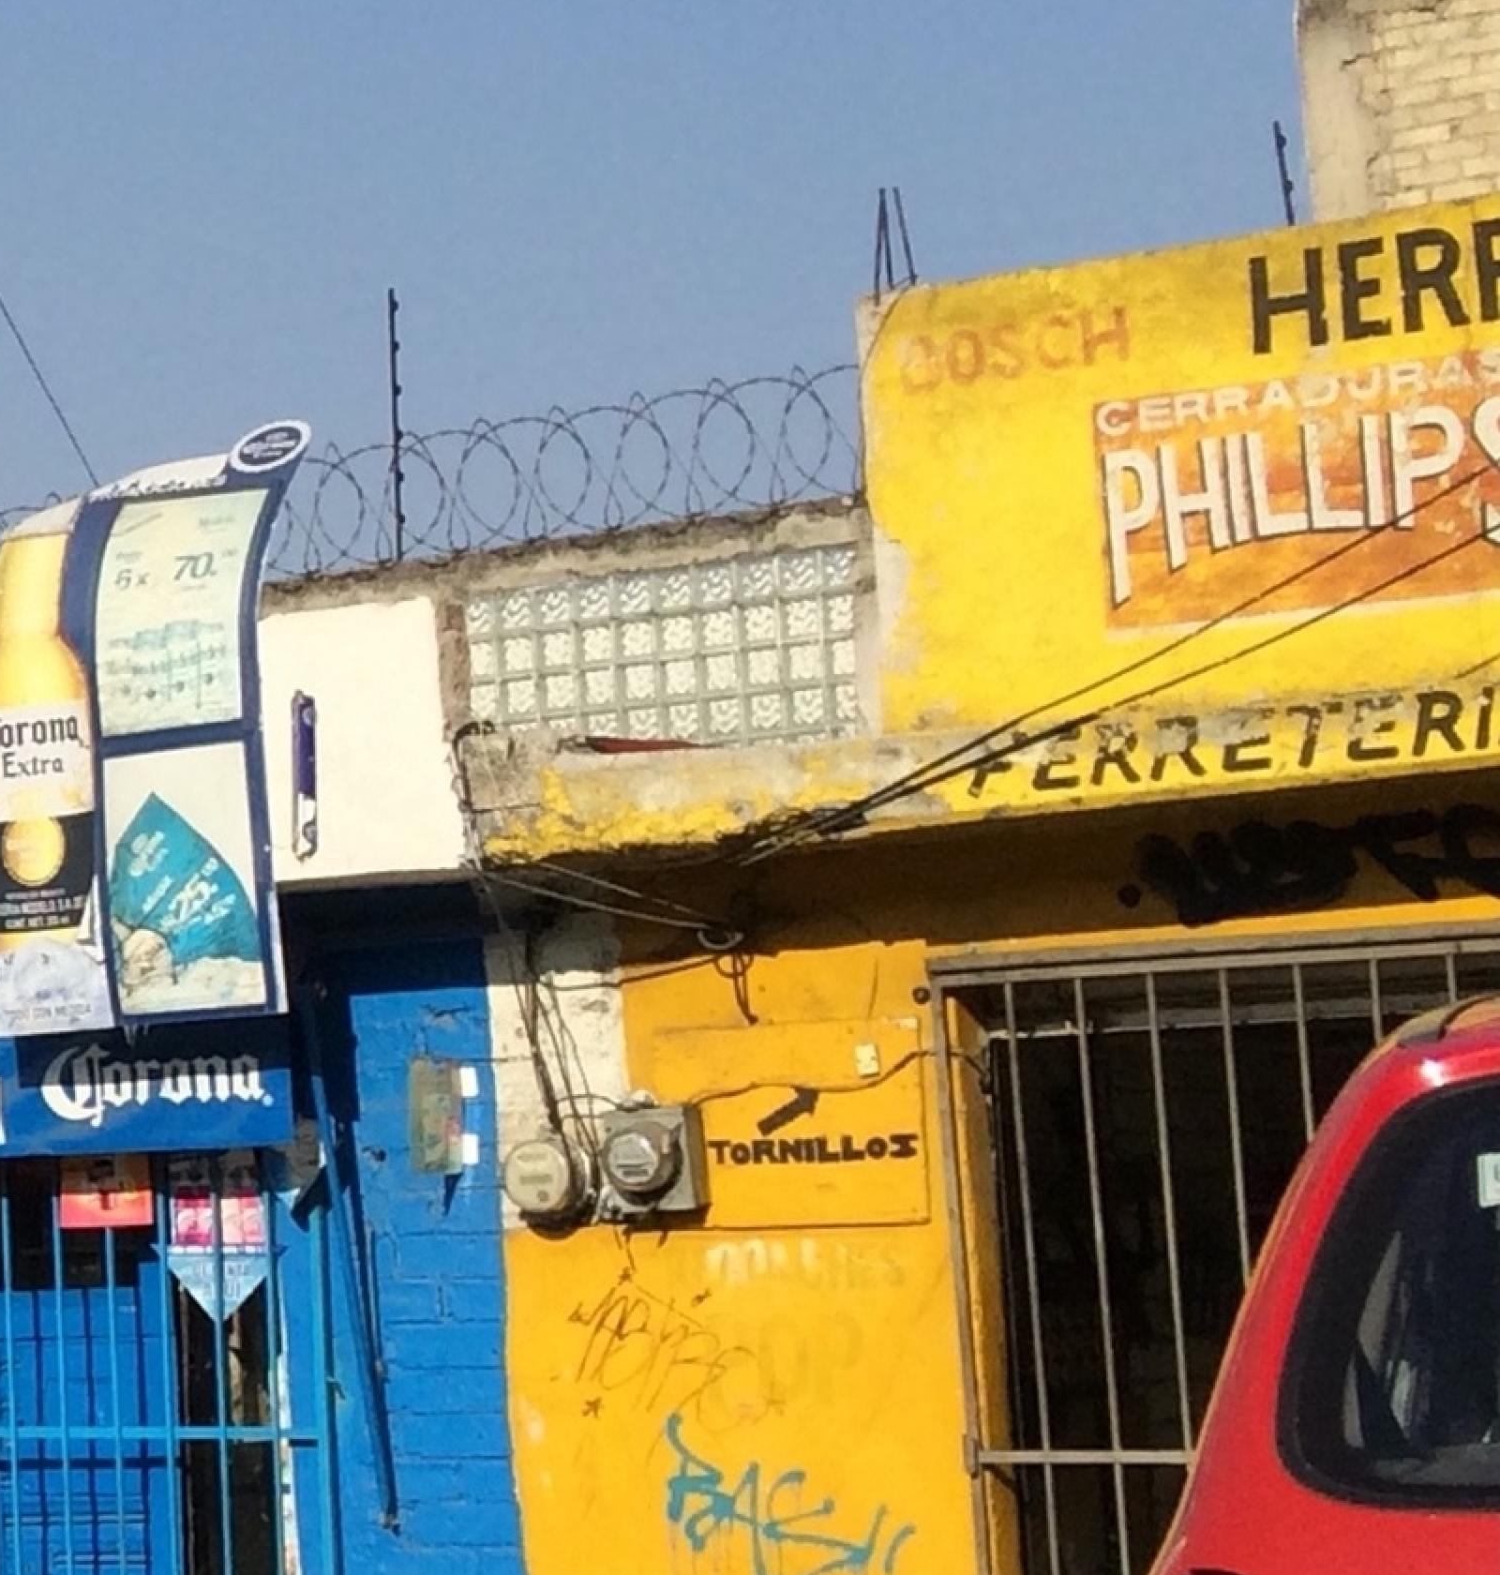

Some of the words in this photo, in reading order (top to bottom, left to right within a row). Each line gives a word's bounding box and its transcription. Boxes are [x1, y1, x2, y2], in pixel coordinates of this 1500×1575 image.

[2, 753, 65, 779] Extra
[968, 685, 1500, 798] FERRETERI
[40, 1043, 268, 1128] Corona
